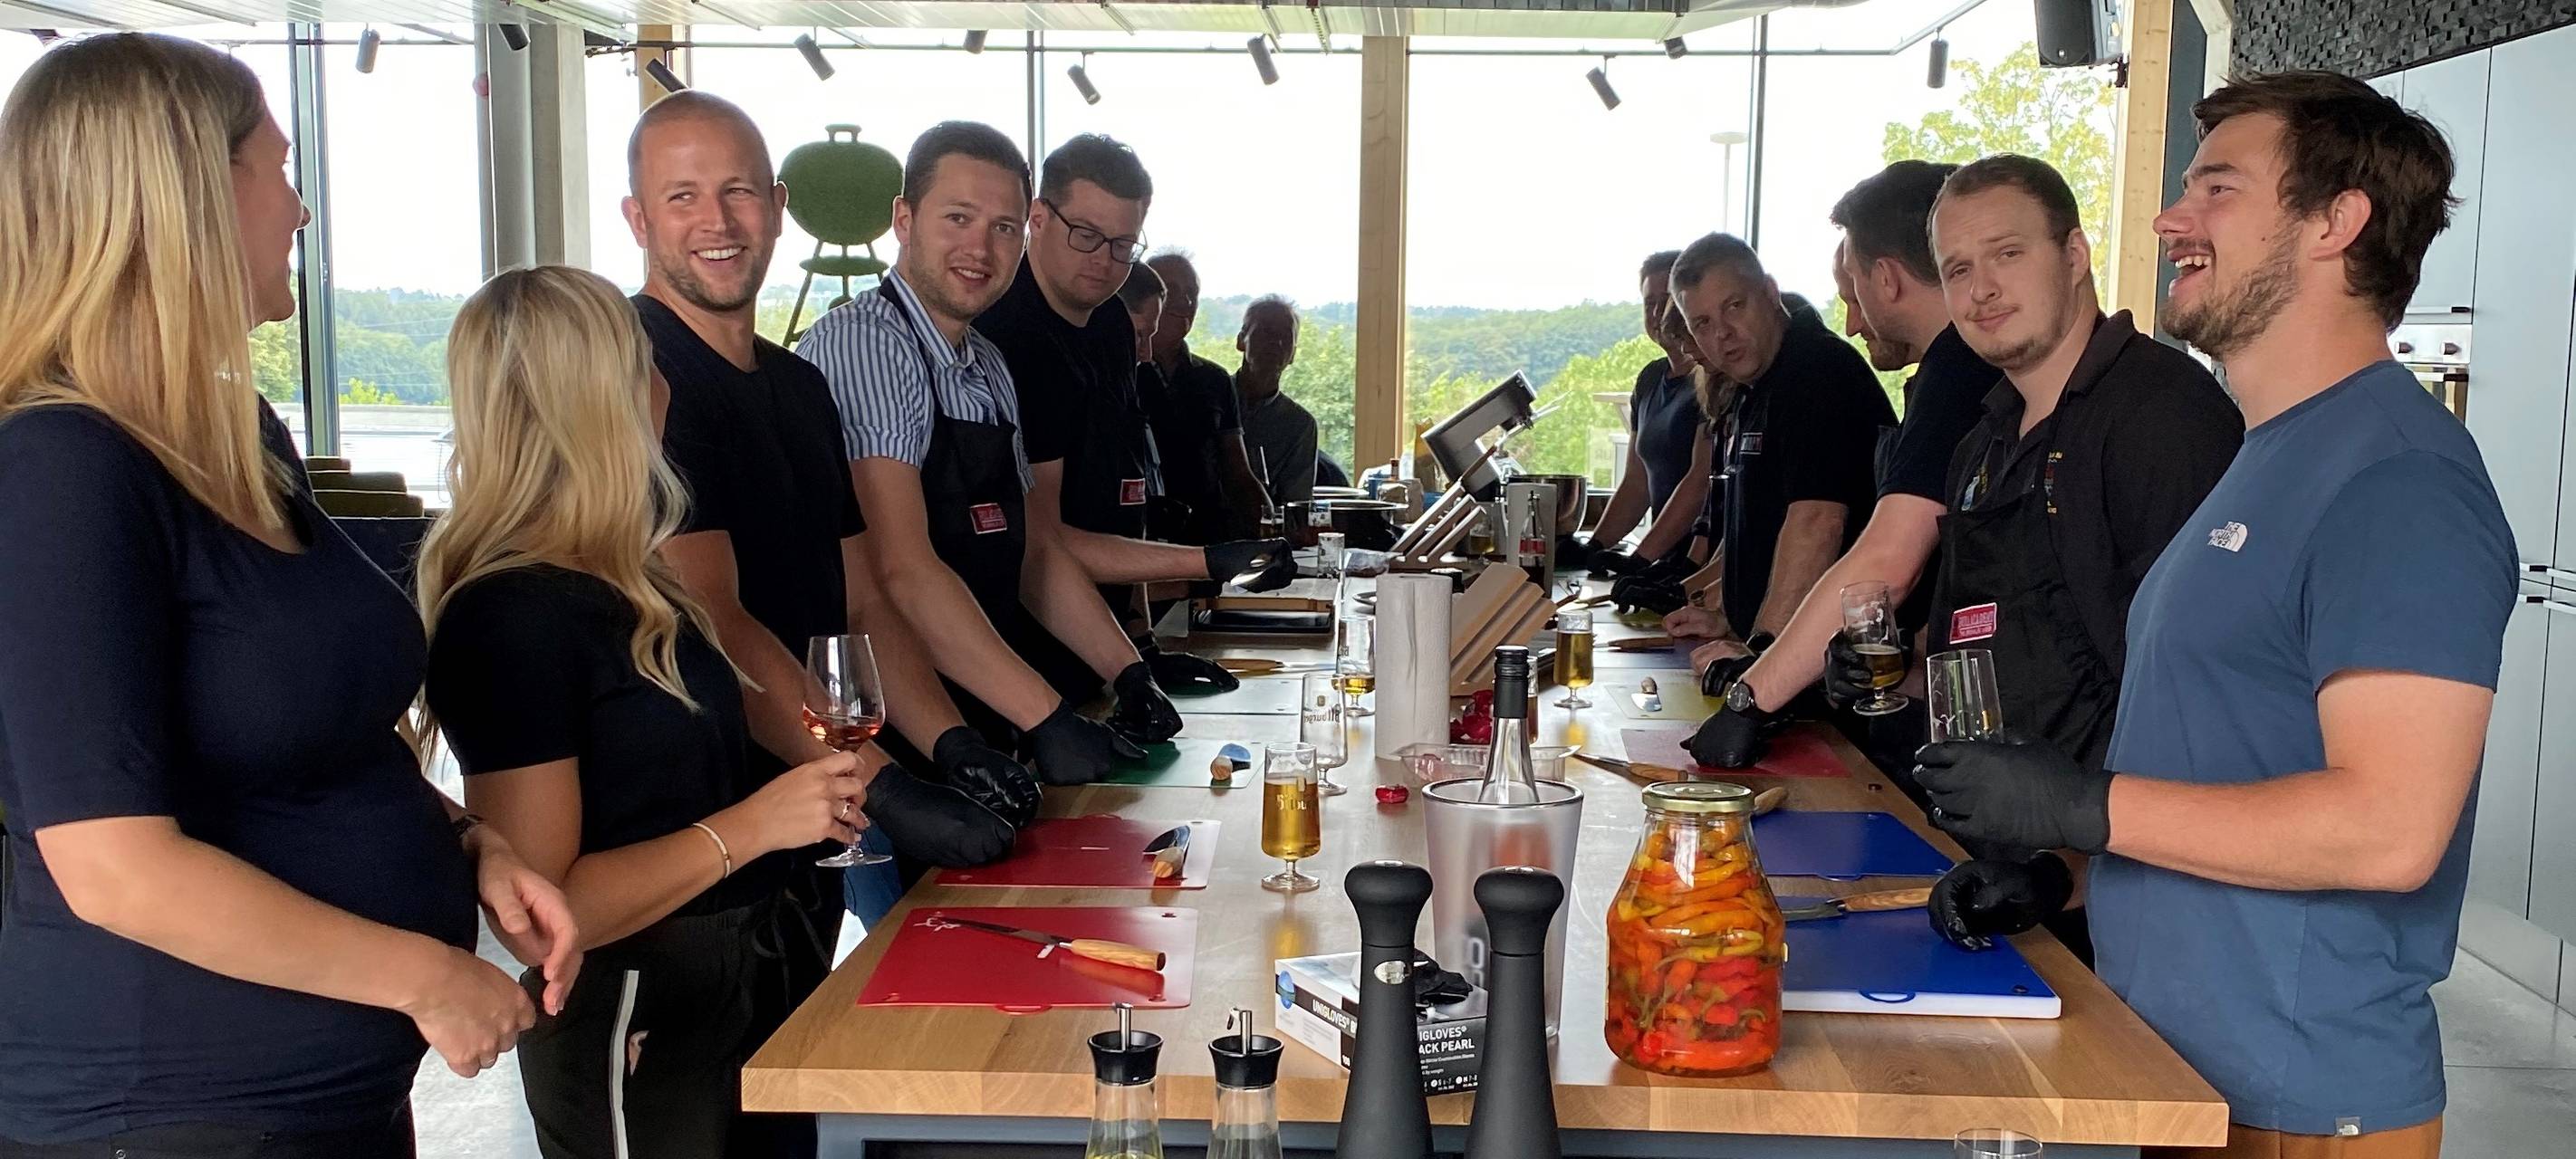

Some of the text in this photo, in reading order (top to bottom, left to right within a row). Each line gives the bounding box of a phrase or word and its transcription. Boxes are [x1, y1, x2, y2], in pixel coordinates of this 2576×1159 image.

[1419, 1025, 1467, 1041] IGLOVES®
[1418, 1038, 1475, 1055] ACK PEARL
